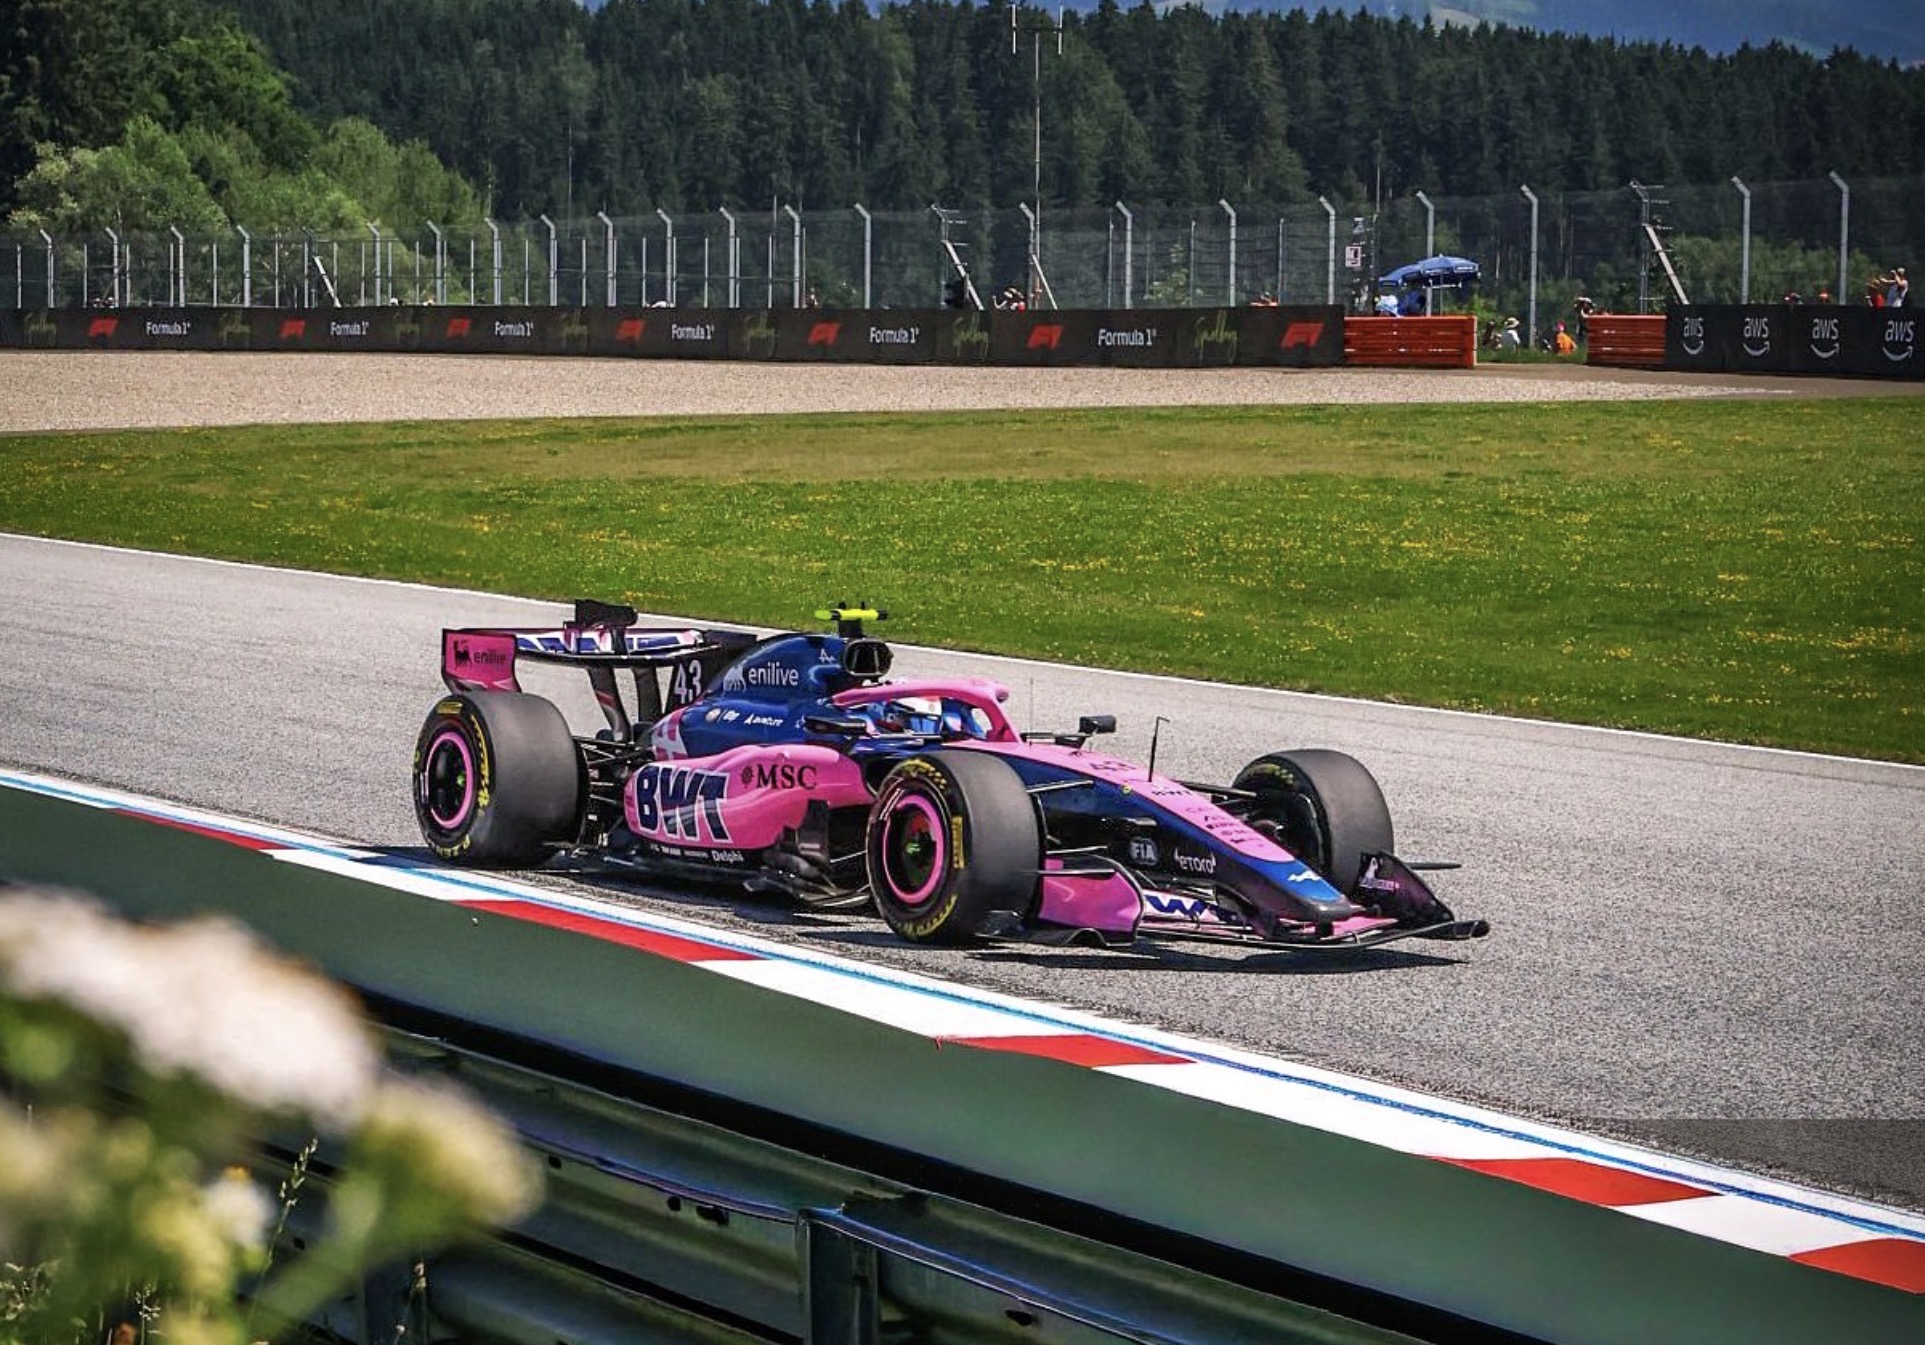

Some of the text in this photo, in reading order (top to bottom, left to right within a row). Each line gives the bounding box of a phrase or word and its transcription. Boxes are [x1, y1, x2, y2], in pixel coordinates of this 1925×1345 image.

[146, 321, 180, 336] Formula
[330, 321, 360, 336] Formula
[494, 321, 525, 337] Formula
[671, 323, 705, 340] Formula
[870, 327, 909, 344] Formula
[1098, 329, 1144, 346] Formula
[1683, 317, 1704, 338] aws
[1743, 318, 1769, 339] aws
[1812, 318, 1839, 340] aws
[1885, 320, 1914, 342] aws
[674, 659, 702, 704] 43
[748, 661, 799, 687] enilive
[756, 763, 818, 790] MSC
[635, 762, 732, 844] BWT
[711, 850, 744, 863] Delphi
[1130, 842, 1157, 861] FIA
